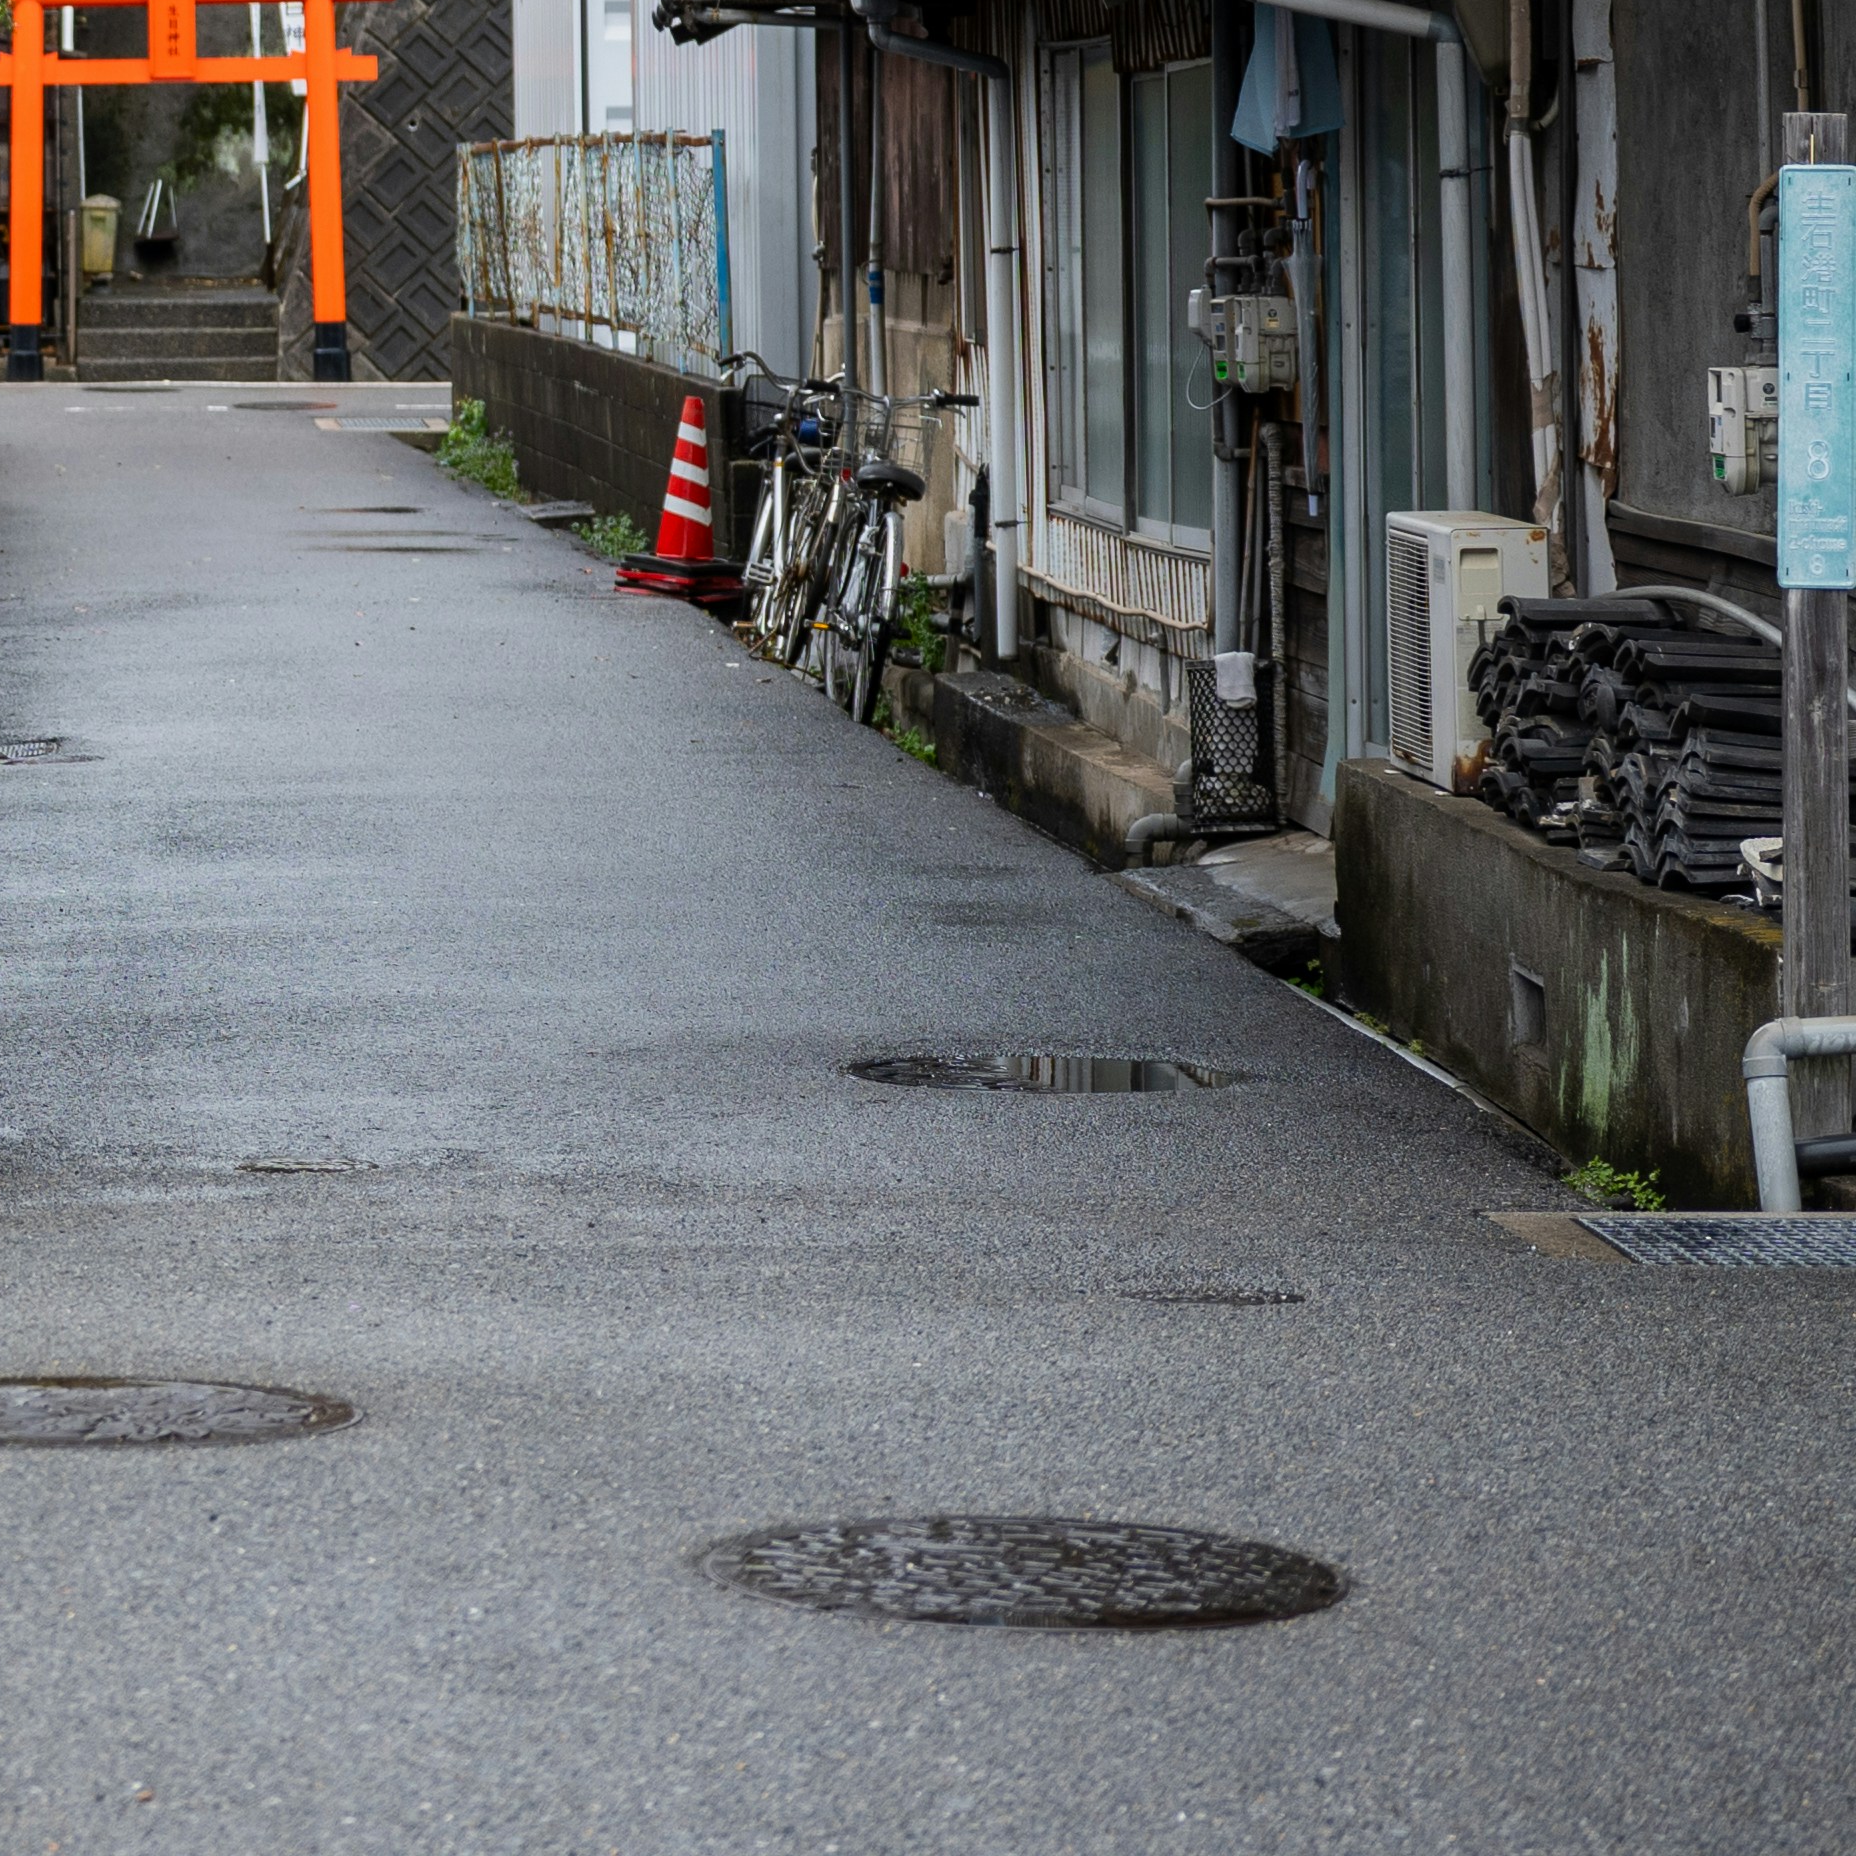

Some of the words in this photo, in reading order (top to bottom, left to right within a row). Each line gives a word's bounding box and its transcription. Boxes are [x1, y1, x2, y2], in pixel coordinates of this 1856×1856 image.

[1800, 190, 1837, 411] 生石港町二丁目
[1807, 439, 1831, 480] 8
